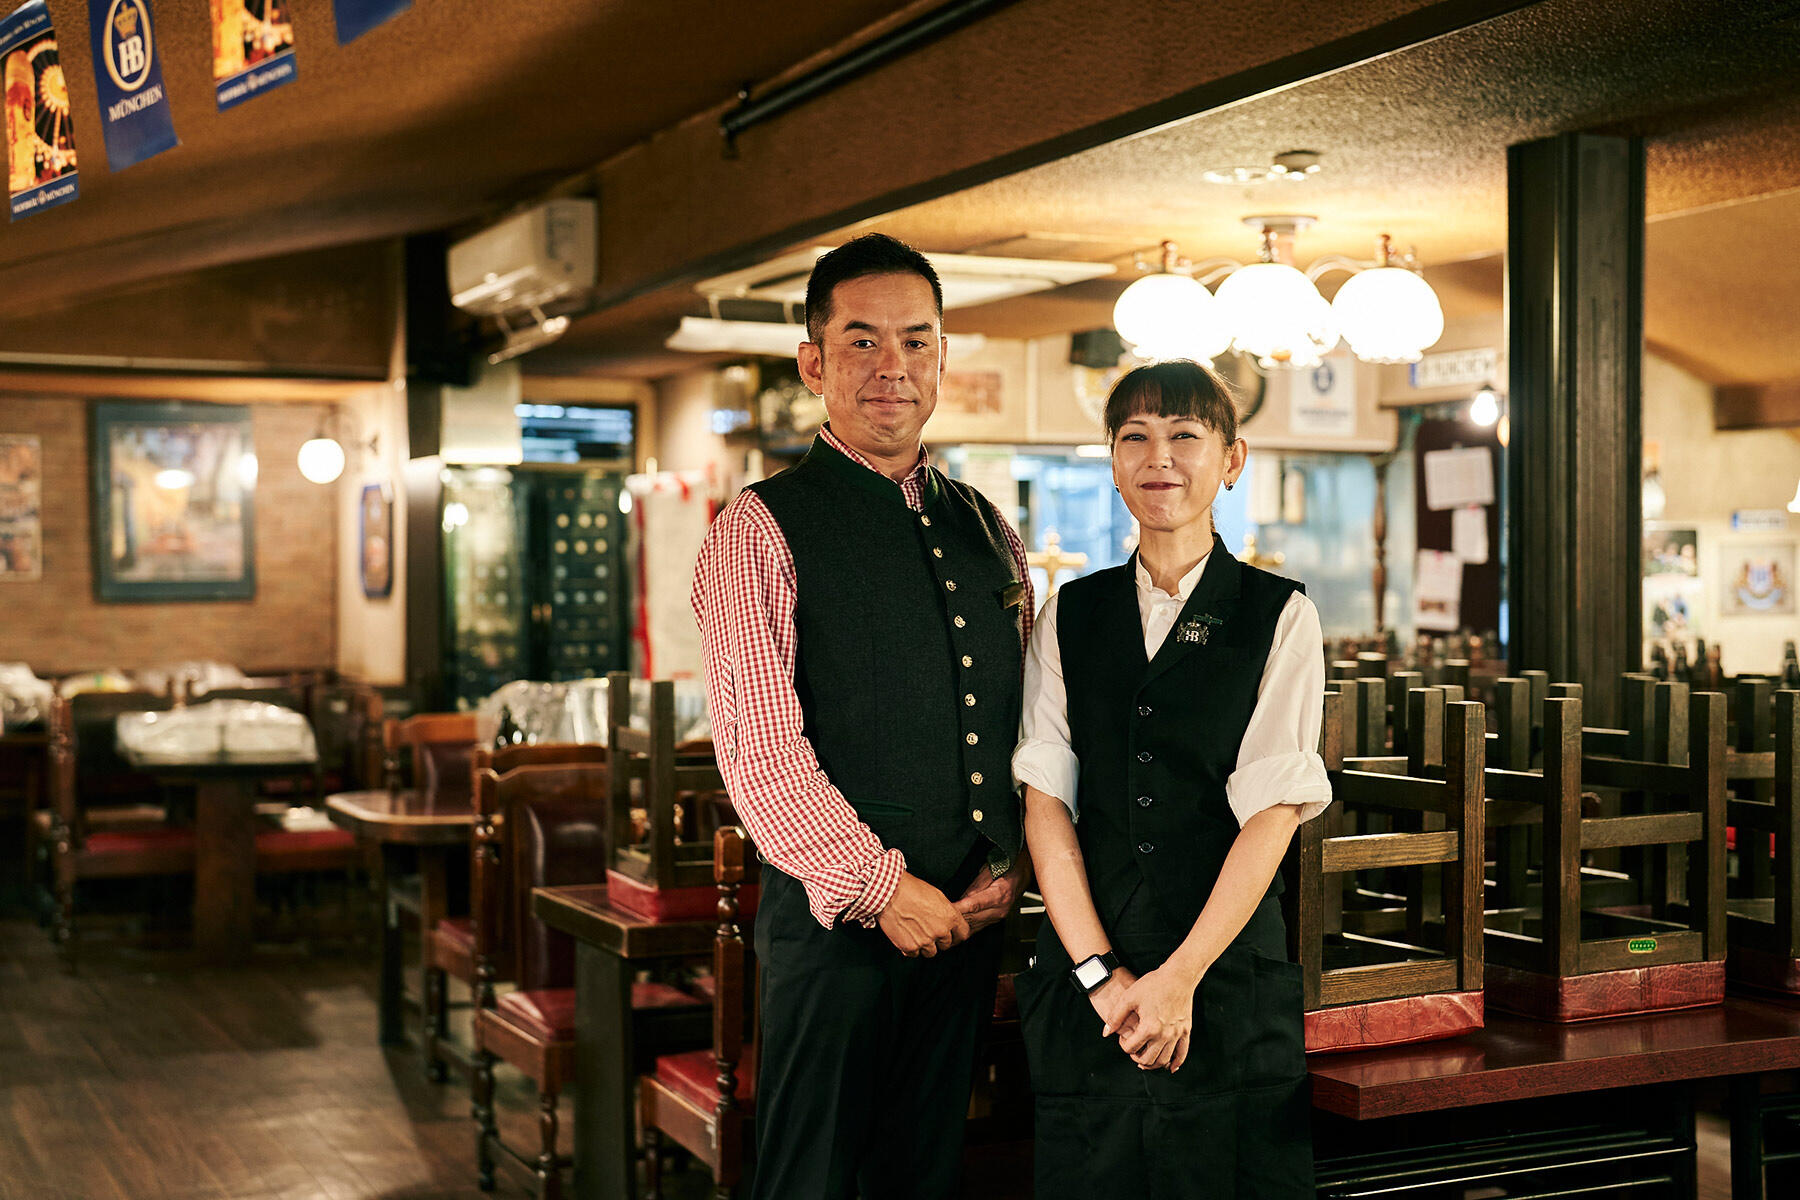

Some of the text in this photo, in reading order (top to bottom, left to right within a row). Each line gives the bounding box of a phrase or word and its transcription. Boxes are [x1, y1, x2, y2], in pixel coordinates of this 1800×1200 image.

[118, 35, 145, 78] HB
[108, 84, 163, 122] MÜNCHEN
[1185, 630, 1200, 642] HB
